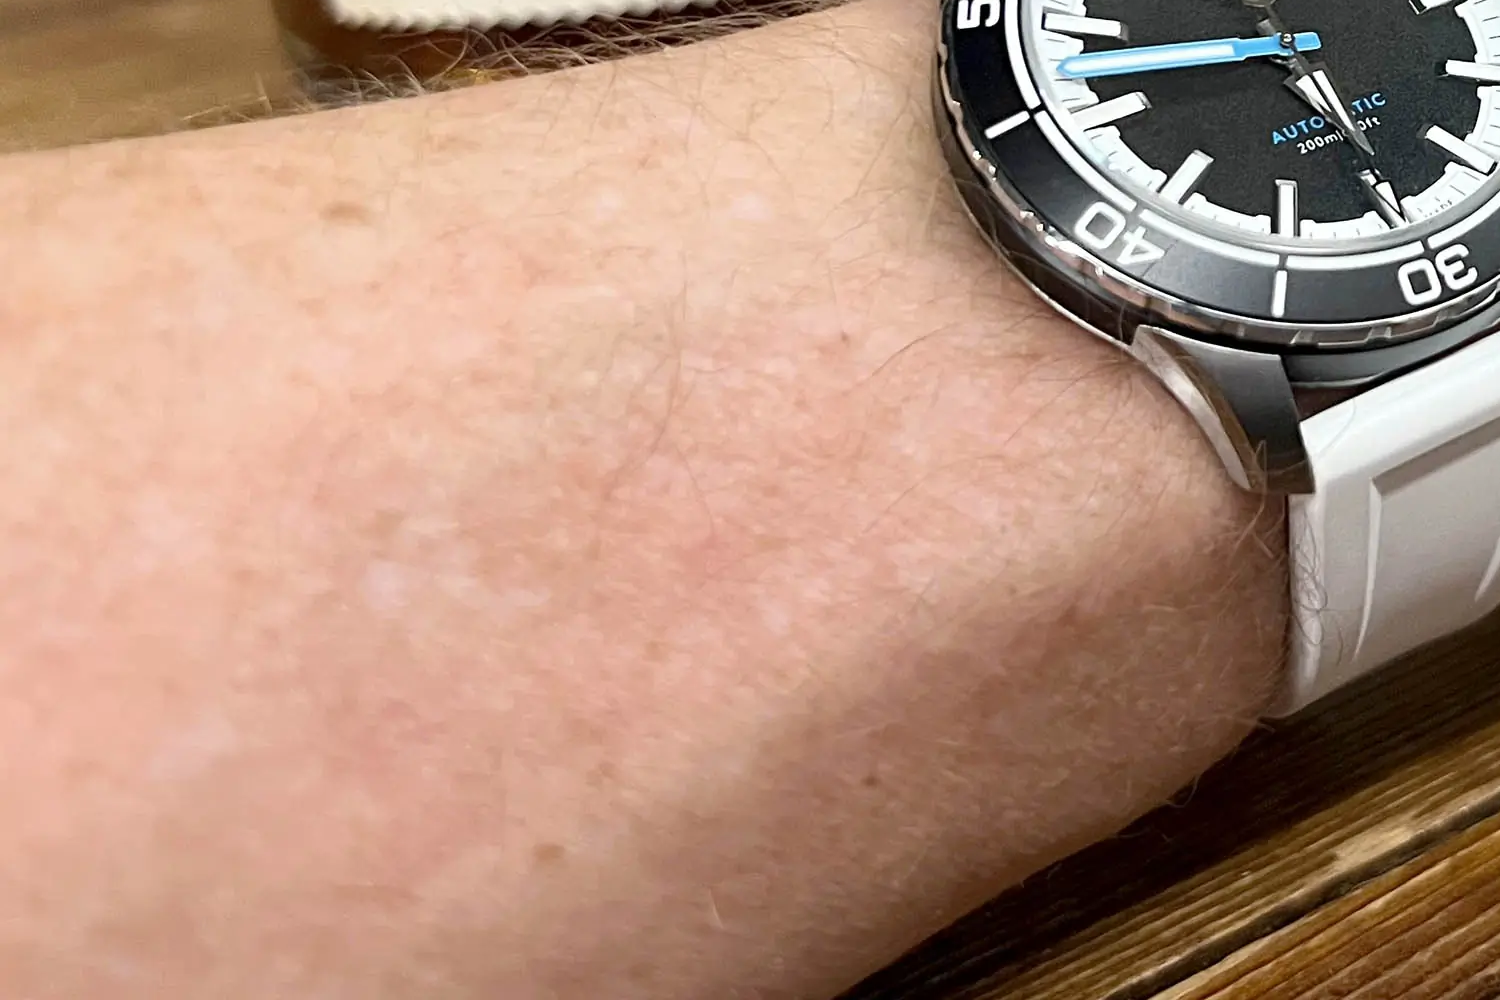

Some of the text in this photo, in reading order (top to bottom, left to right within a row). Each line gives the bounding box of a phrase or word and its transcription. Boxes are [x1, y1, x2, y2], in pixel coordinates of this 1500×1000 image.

[1271, 92, 1387, 145] AUTOTIC
[1074, 201, 1165, 265] 40
[1398, 243, 1478, 306] 30
